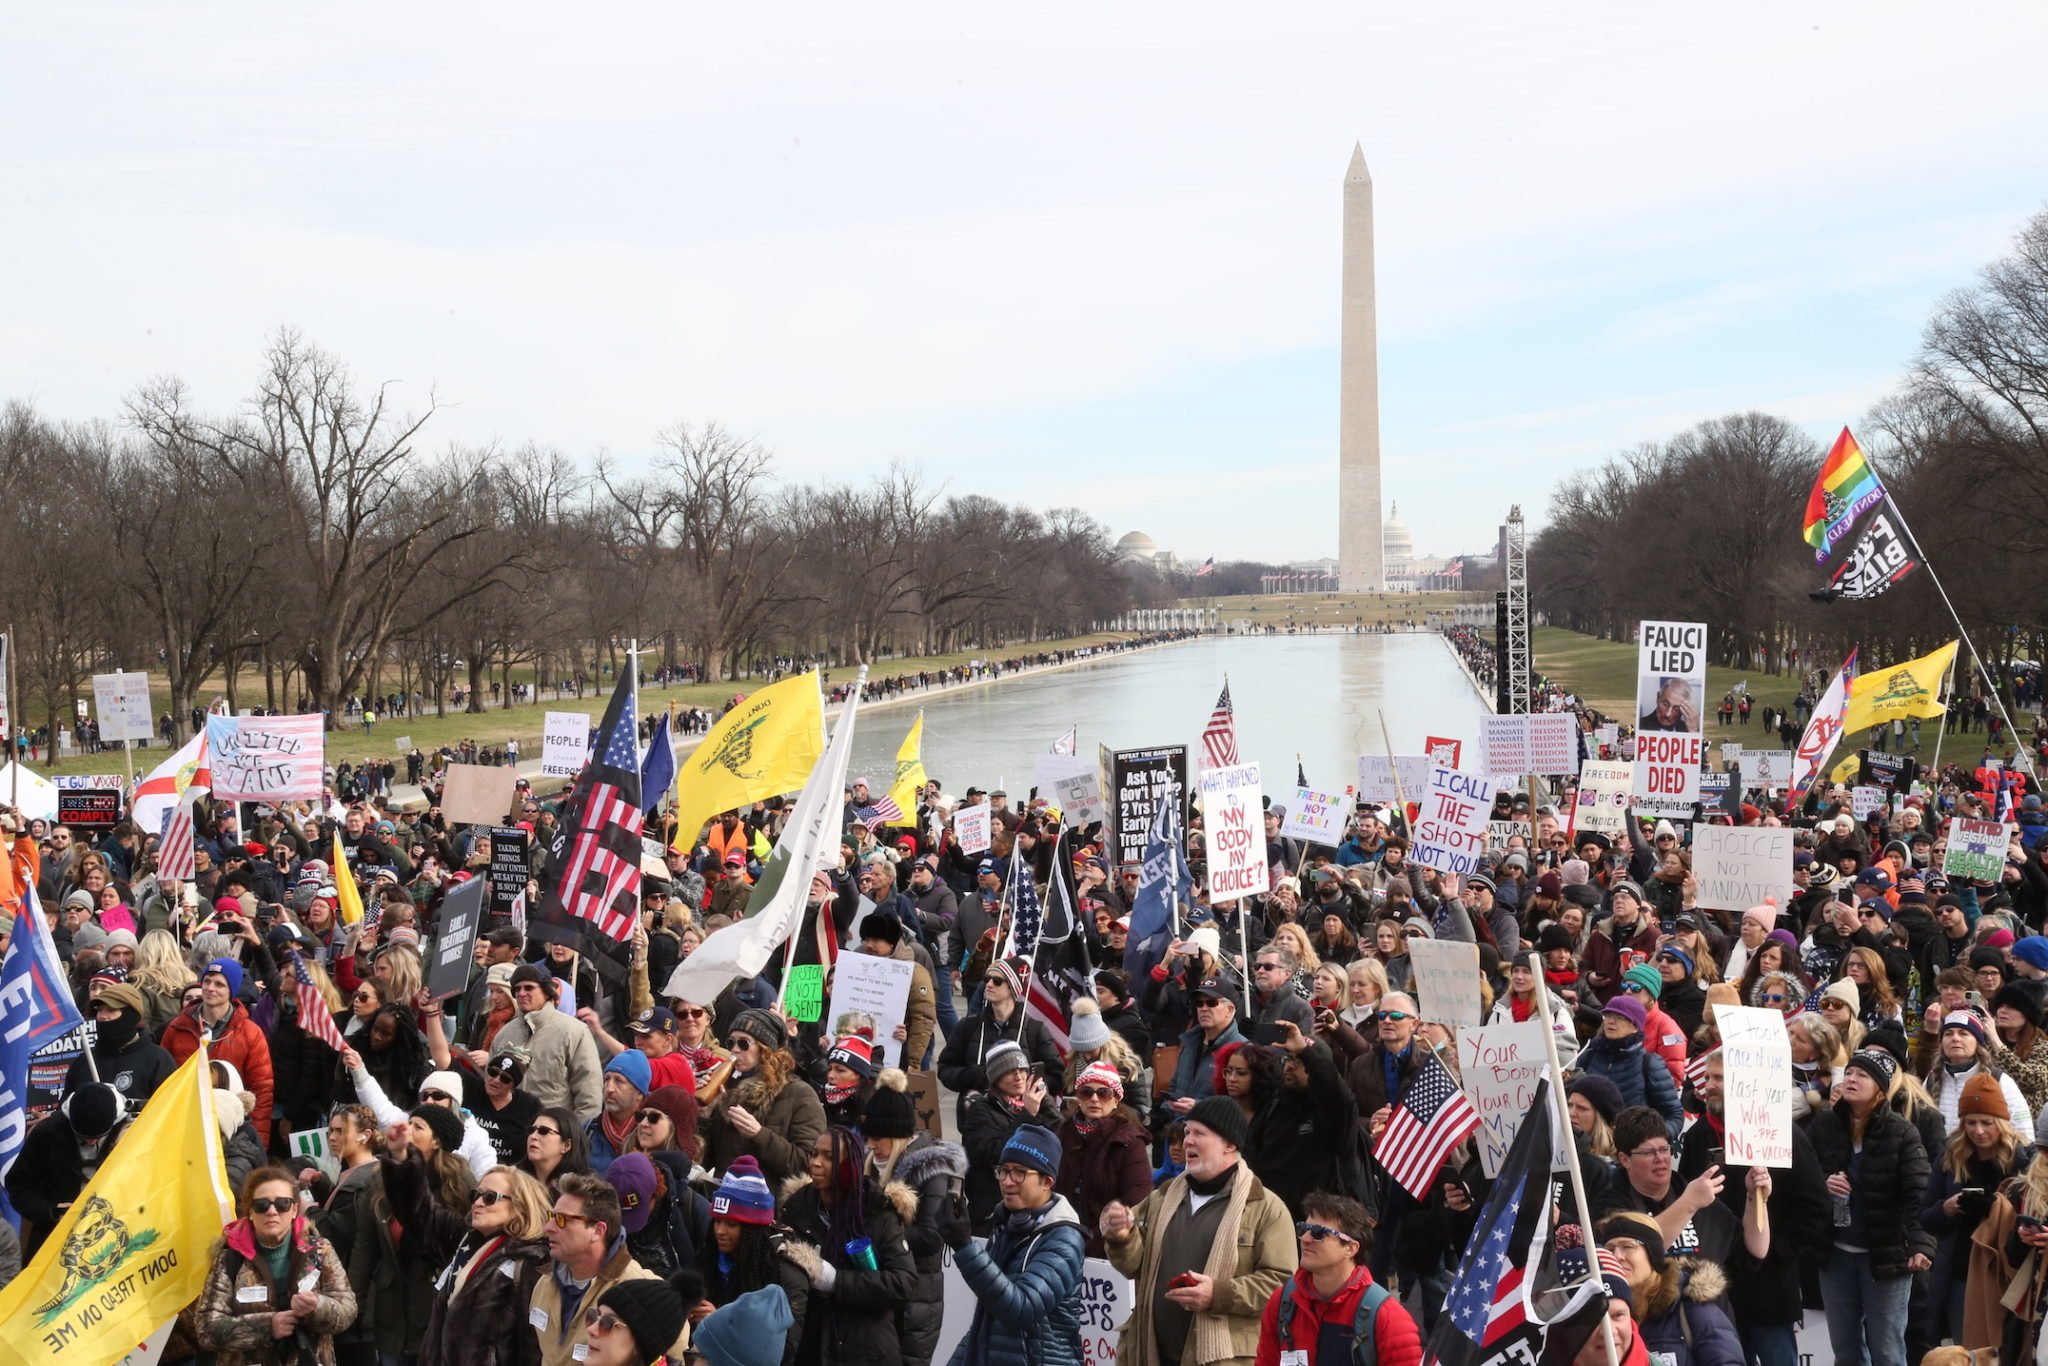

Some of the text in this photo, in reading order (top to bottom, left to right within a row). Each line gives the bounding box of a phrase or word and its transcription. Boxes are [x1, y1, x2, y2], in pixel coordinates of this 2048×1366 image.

[1645, 626, 1702, 649] FAUCI
[1650, 651, 1695, 673] LIED
[217, 731, 301, 757] UNITED
[546, 735, 581, 748] PEOPLE
[1637, 736, 1700, 764] PEOPLE
[1118, 748, 1183, 760] DEFEAT THE MANDATES
[1126, 772, 1148, 786] Ask
[1203, 767, 1259, 793] WHAT HAPPENED
[1585, 769, 1630, 780] FREEDOM
[1648, 767, 1685, 794] DIED
[1120, 786, 1149, 801] Gov't
[1432, 769, 1449, 788] I
[1450, 773, 1491, 803] CALL
[1227, 794, 1238, 806] TO
[1297, 789, 1341, 806] FREEDOM
[1599, 794, 1610, 802] OF
[60, 811, 116, 822] COMPLY
[1122, 802, 1151, 816] 2 Yrs
[1304, 803, 1327, 816] NOT
[1435, 792, 1475, 827] THE
[1122, 817, 1151, 832] Early
[1585, 816, 1619, 827] CHOICE
[1217, 824, 1253, 851] BODY
[1421, 821, 1481, 852] SHOT
[1697, 828, 1784, 860] CHOICE
[1971, 832, 2005, 848] STAND
[497, 844, 520, 853] TAKING
[497, 854, 520, 862] THINGS
[1230, 848, 1247, 868] MY
[1412, 842, 1445, 867] NOT
[492, 863, 528, 873] AWAY UNTIL
[1448, 855, 1478, 877] YOU
[1718, 861, 1751, 877] NOT
[1946, 848, 2004, 871] HEALTH
[503, 873, 513, 882] SAY
[514, 874, 527, 883] YES
[503, 883, 515, 891] NOT
[1695, 878, 1784, 905] MANDATES
[448, 913, 467, 933] EARLY
[439, 926, 471, 952] TREATMENT
[1720, 1012, 1740, 1039] I
[1466, 1033, 1520, 1068] YOUR
[1728, 1047, 1752, 1068] care
[1491, 1065, 1537, 1083] BODY
[1730, 1072, 1786, 1106] last year
[1471, 1086, 1512, 1114] YOUR
